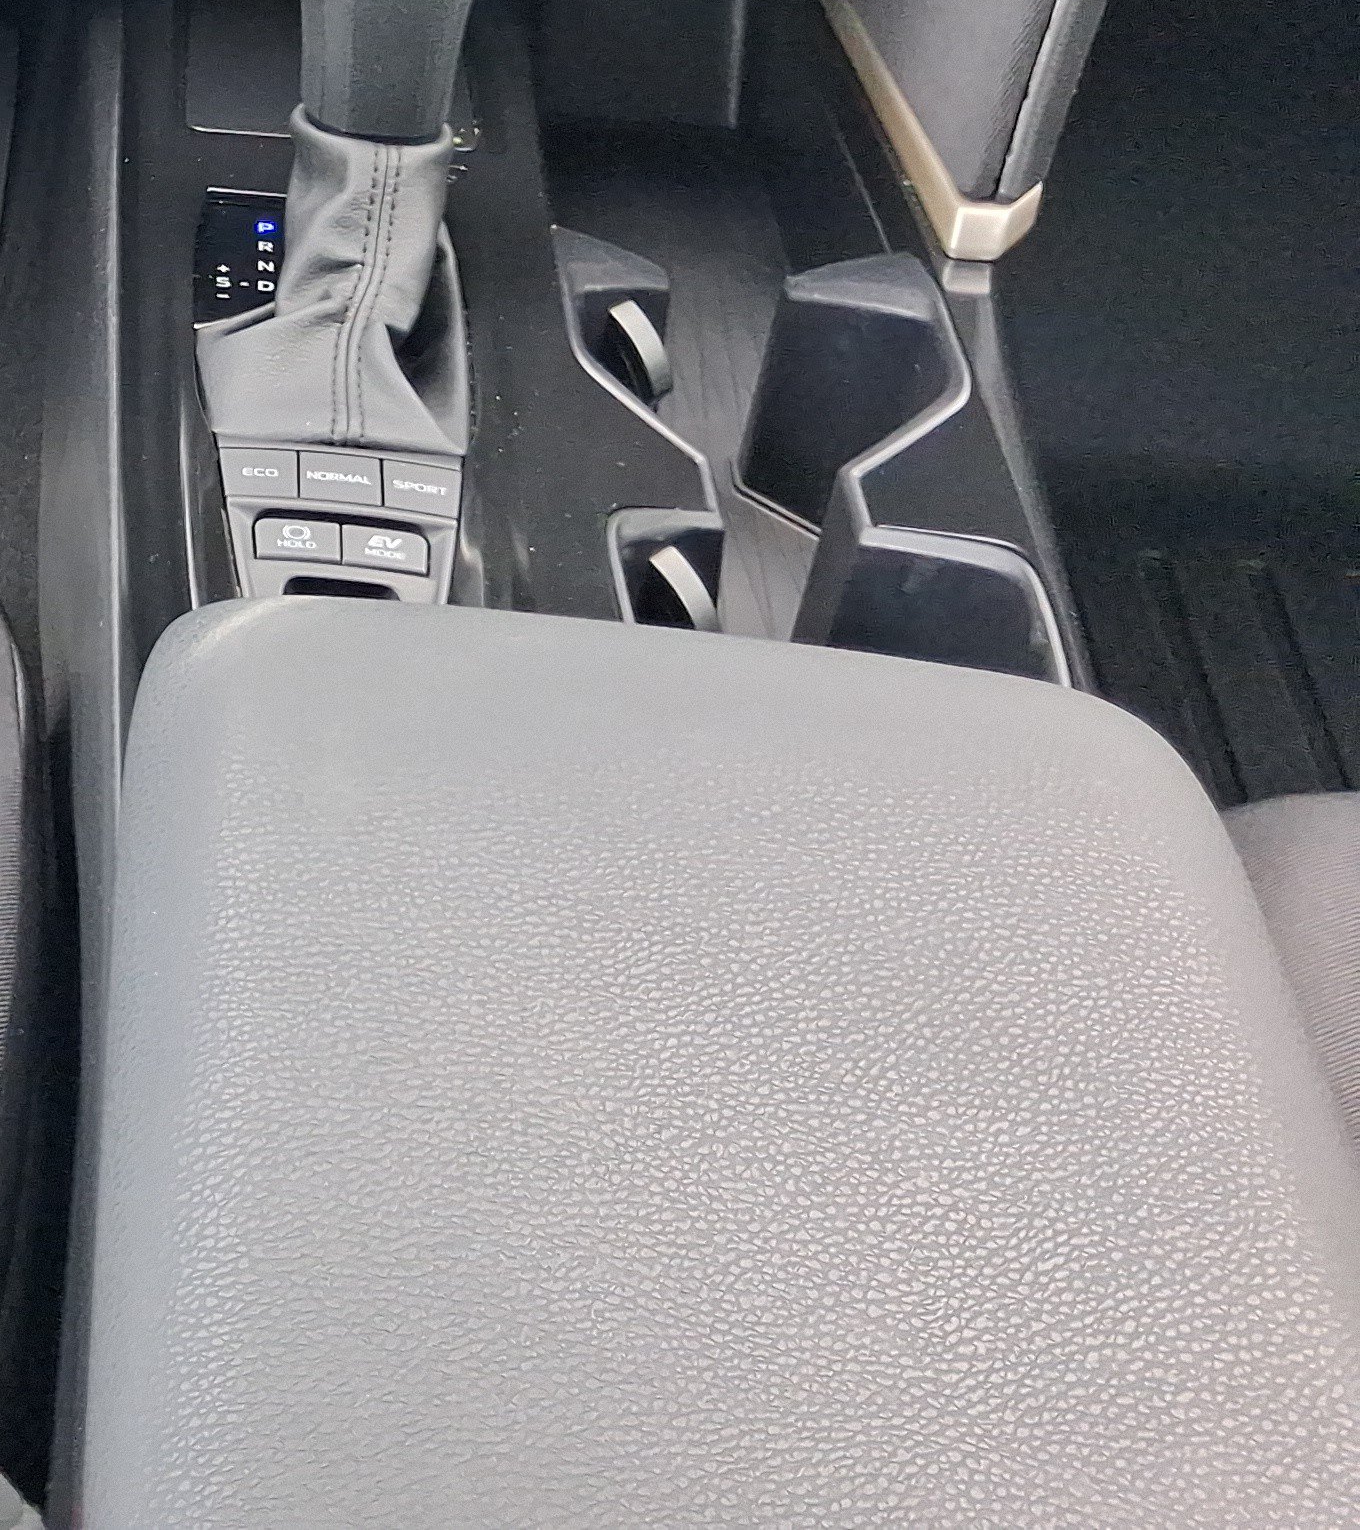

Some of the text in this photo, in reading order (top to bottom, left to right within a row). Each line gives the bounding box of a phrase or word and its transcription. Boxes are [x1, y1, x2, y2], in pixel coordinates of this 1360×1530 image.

[257, 221, 275, 234] P
[257, 240, 274, 253] R
[257, 259, 276, 273] N
[215, 276, 232, 288] S
[257, 280, 275, 292] D
[241, 466, 279, 478] ECO
[306, 470, 372, 487] NORMAL
[392, 479, 448, 497] SPORT
[277, 537, 318, 550] HOLD
[367, 534, 403, 549] EV
[364, 547, 407, 560] MODE
